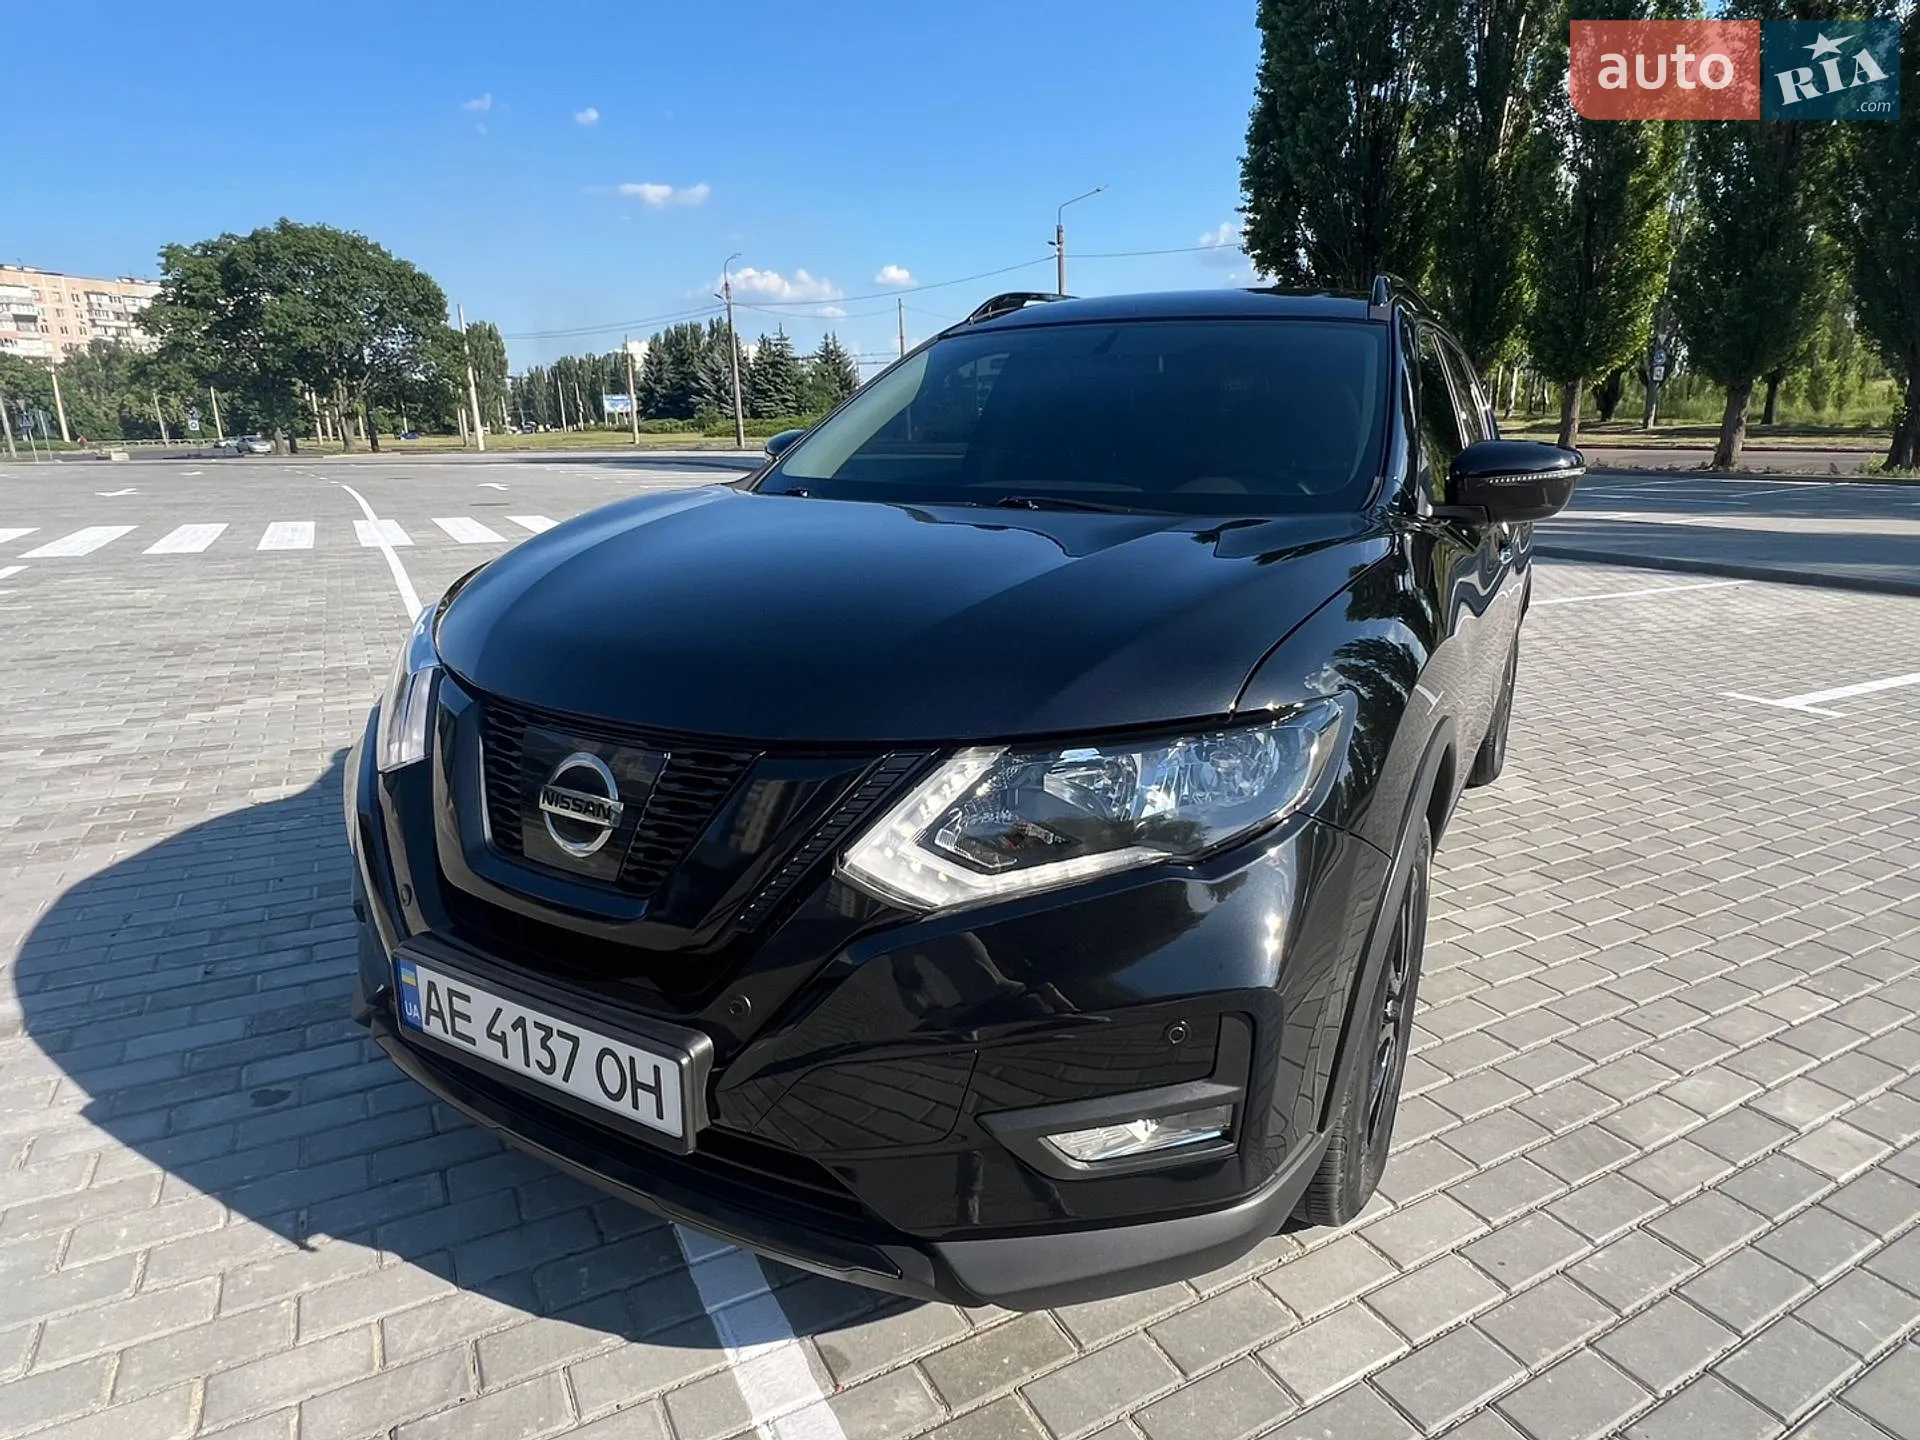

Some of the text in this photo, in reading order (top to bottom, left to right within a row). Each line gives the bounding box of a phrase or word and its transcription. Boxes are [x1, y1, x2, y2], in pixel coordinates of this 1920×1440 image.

[541, 789, 612, 820] NISSAN
[404, 1000, 420, 1021] UA
[424, 979, 664, 1121] AE 4137 OH
